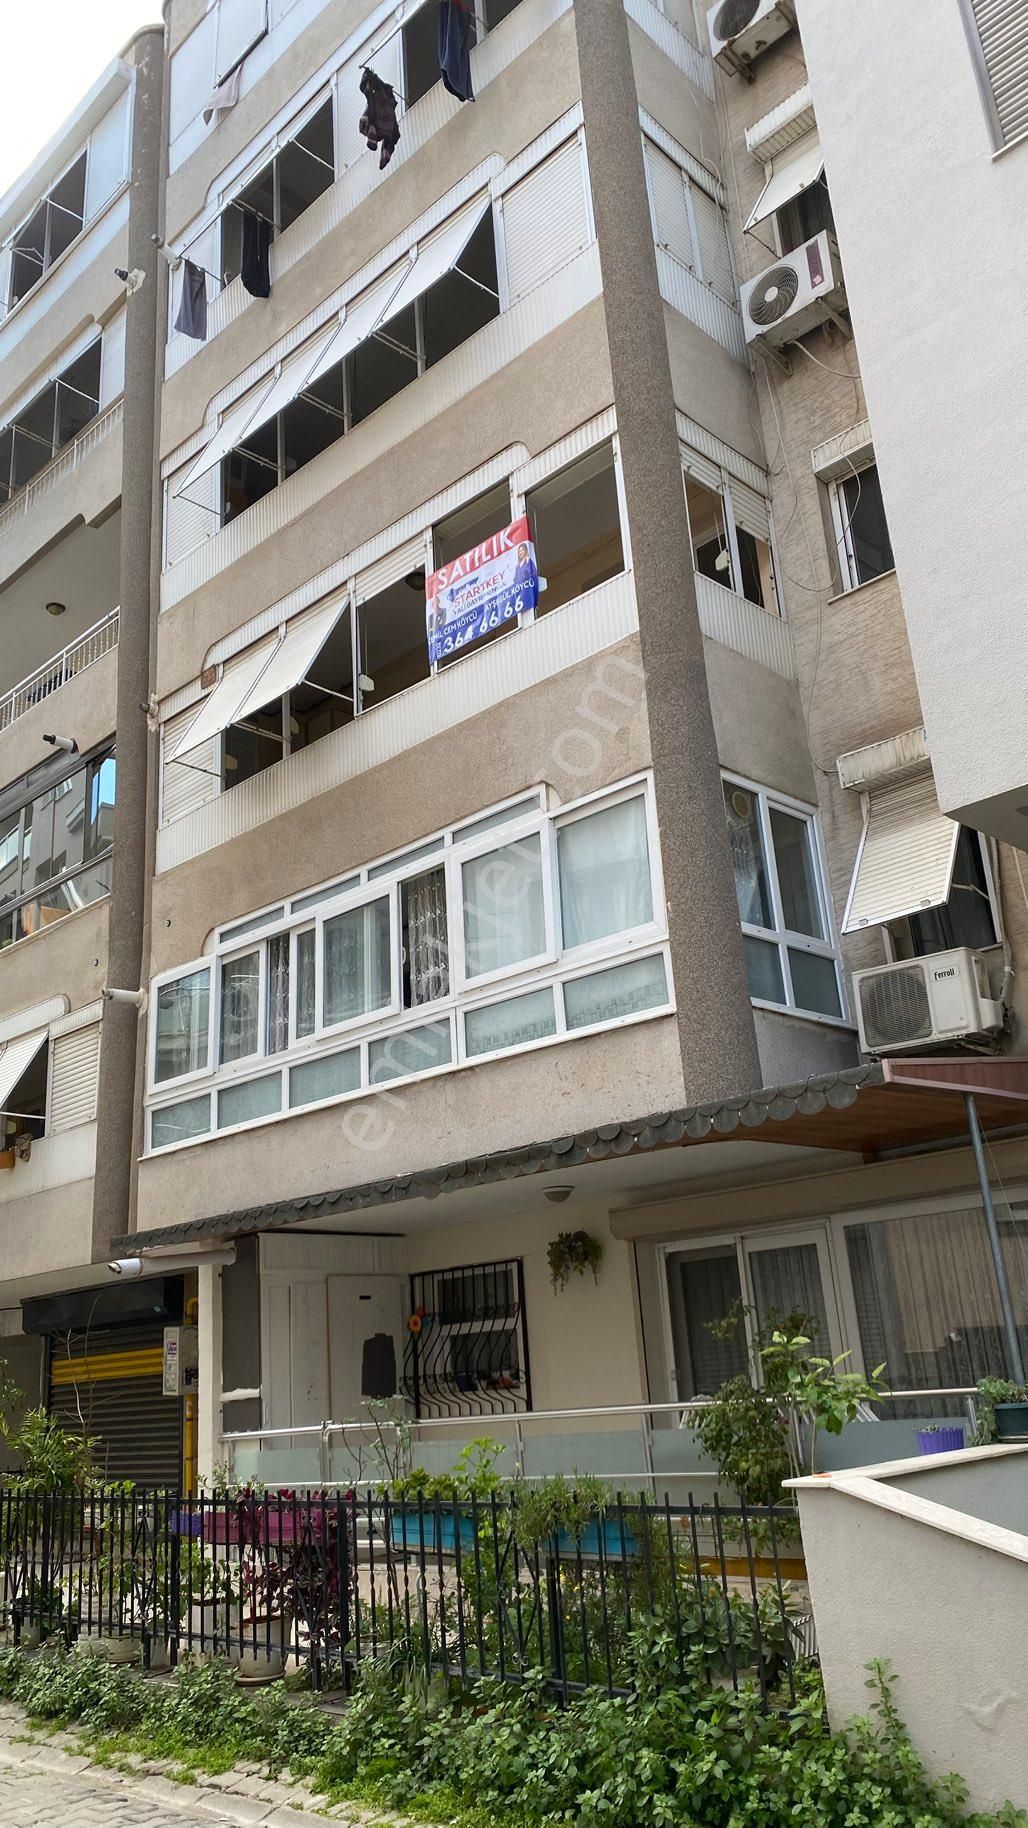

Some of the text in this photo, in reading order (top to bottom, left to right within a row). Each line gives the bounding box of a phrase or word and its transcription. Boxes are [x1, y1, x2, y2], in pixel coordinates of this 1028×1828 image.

[438, 526, 514, 589] SATILIK
[453, 569, 505, 608] STARTKEY
[443, 595, 524, 653] 364 66 66
[444, 623, 457, 635] CEM
[457, 610, 478, 628] KÖYCÜ
[934, 968, 955, 981] Ferroli
